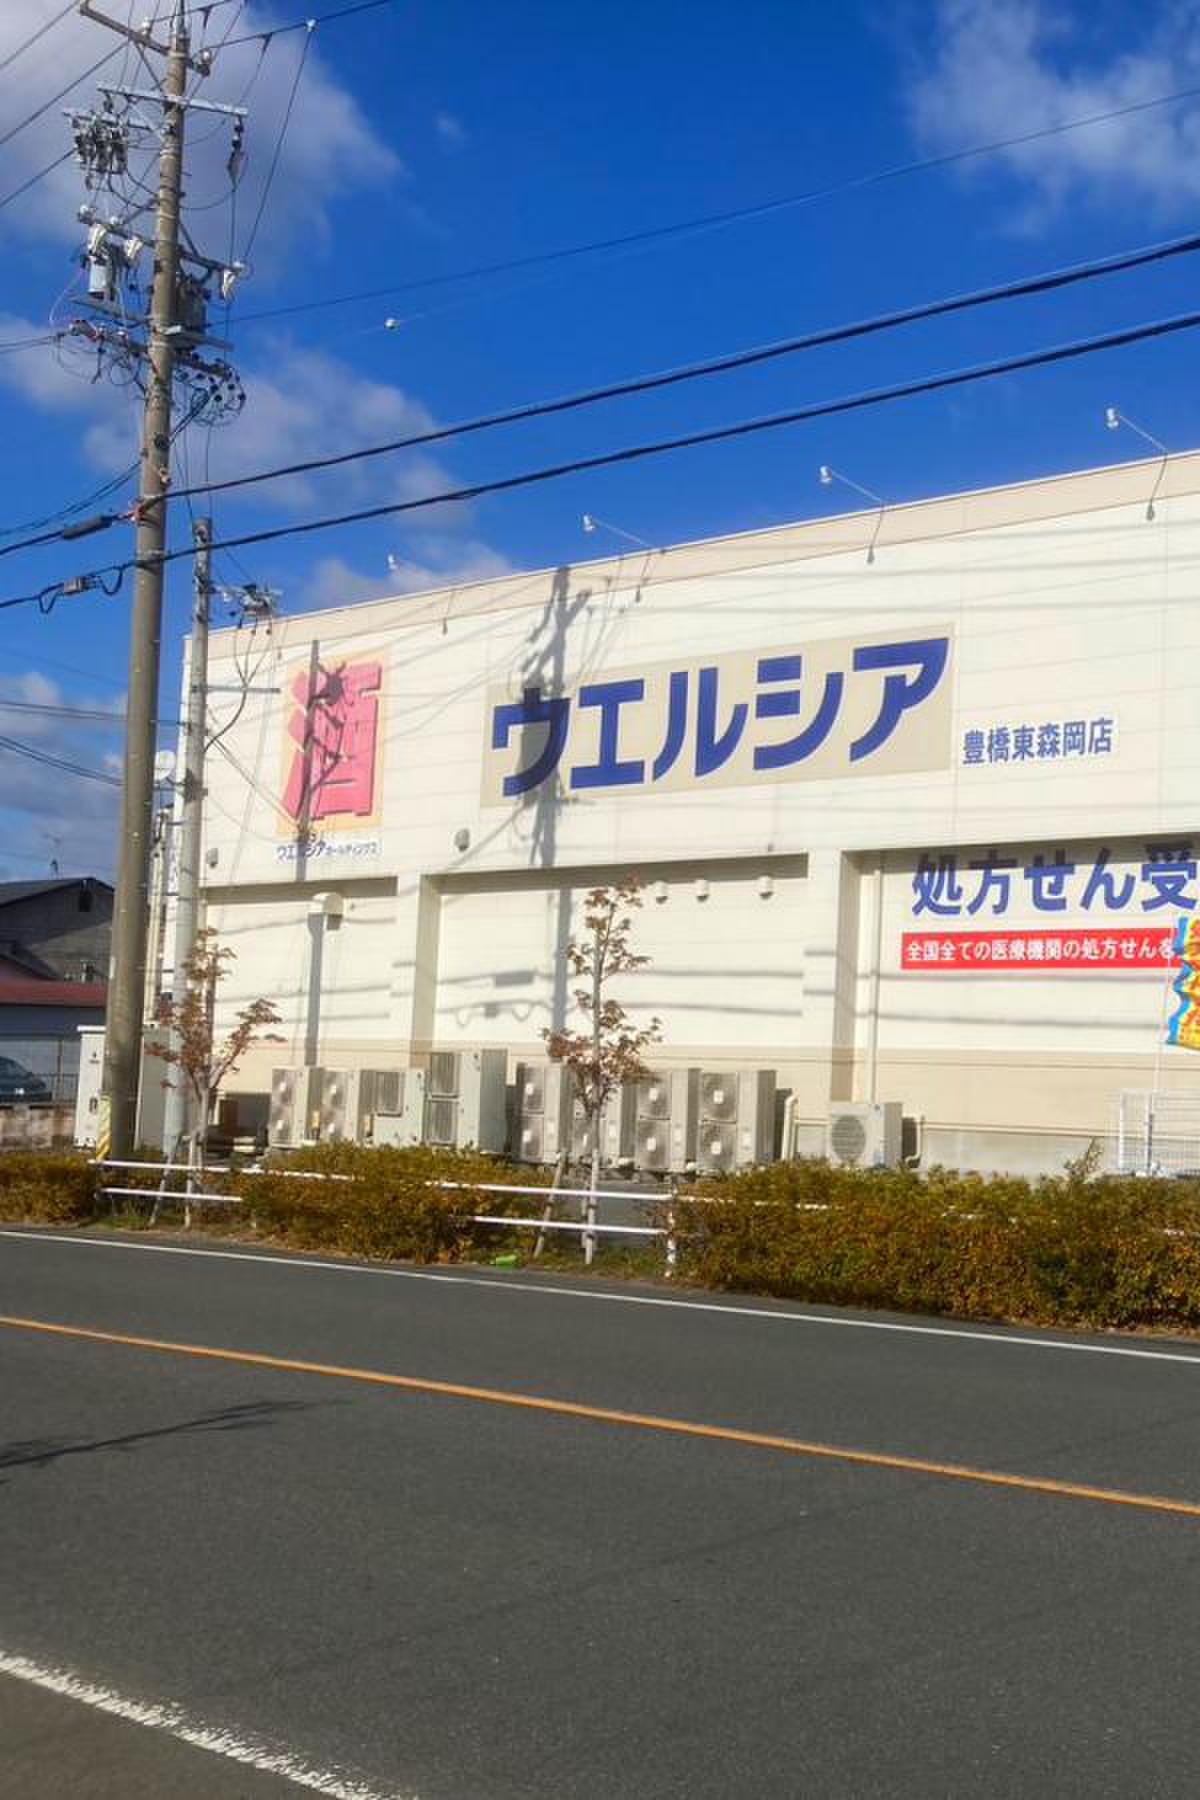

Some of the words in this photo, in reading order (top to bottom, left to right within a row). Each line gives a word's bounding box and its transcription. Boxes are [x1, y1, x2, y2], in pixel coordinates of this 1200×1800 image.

[491, 636, 949, 798] ウエルシア
[962, 716, 1114, 766] 豊橋東森岡店
